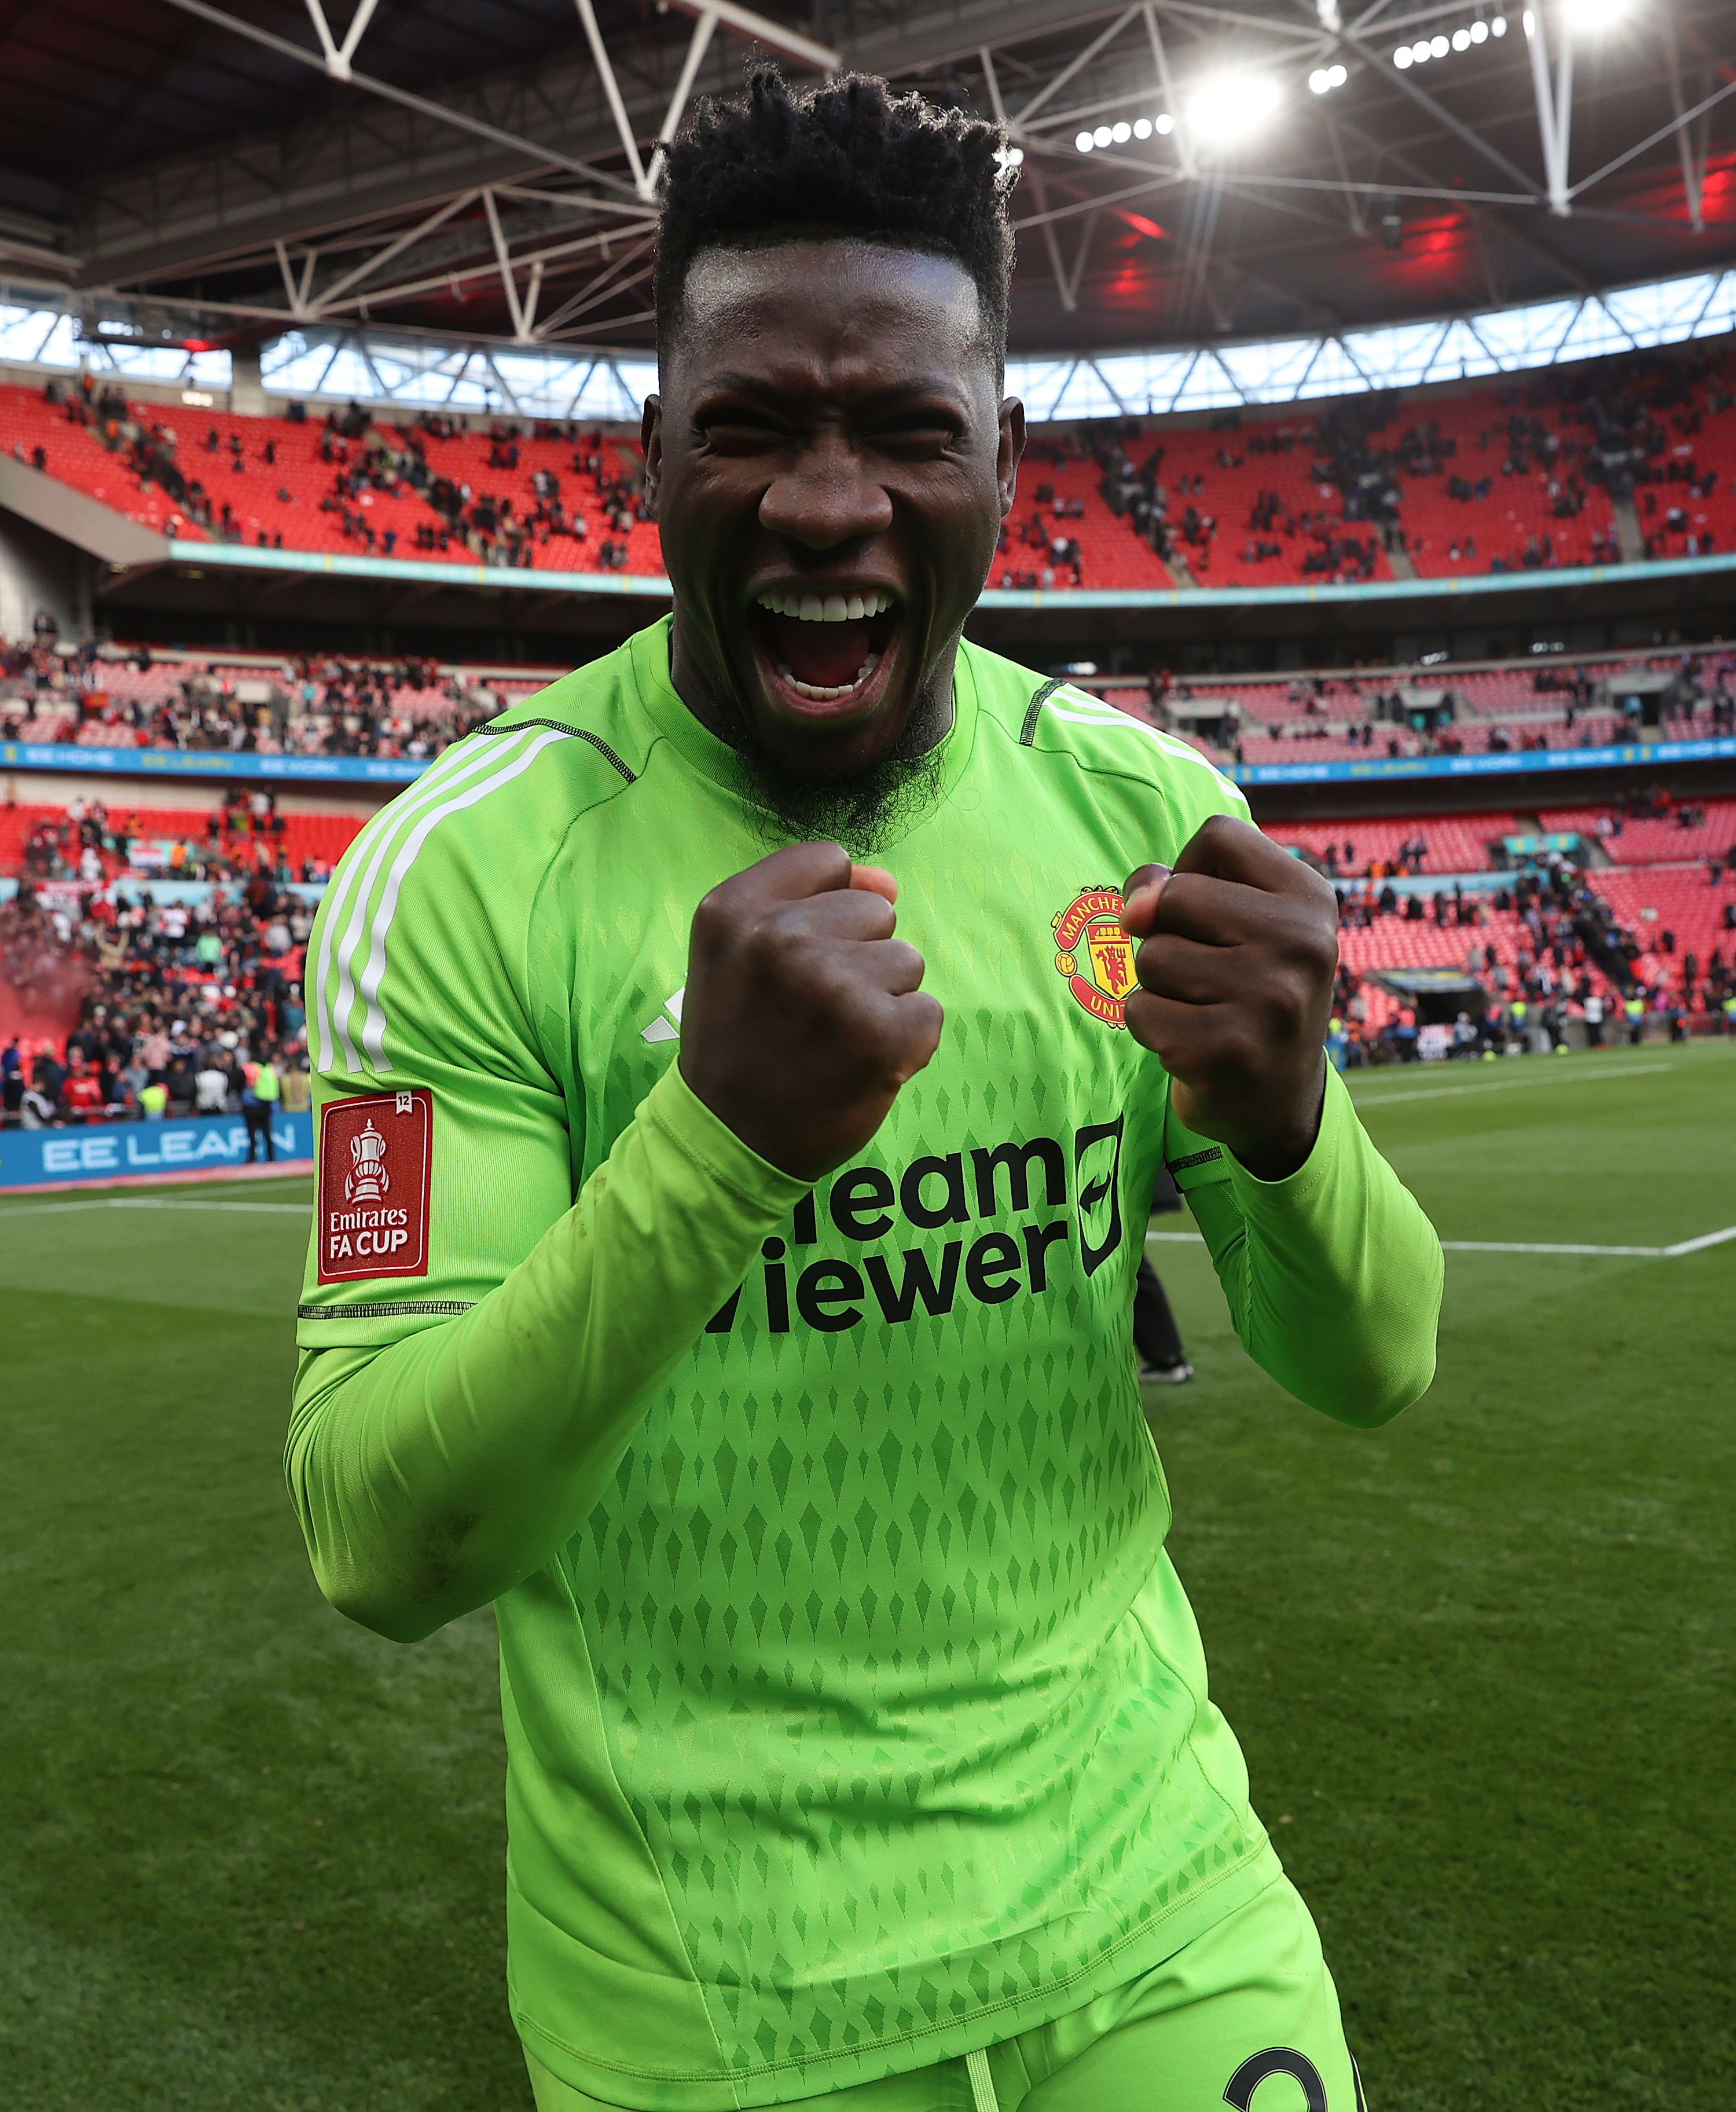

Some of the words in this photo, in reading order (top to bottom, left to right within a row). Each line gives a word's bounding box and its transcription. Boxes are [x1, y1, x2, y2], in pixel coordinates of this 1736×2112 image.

[398, 1095, 409, 1106] 12
[42, 1137, 119, 1172] EE
[331, 1208, 408, 1232] Emirates
[331, 1235, 352, 1259] FA
[356, 1230, 408, 1255] CUP
